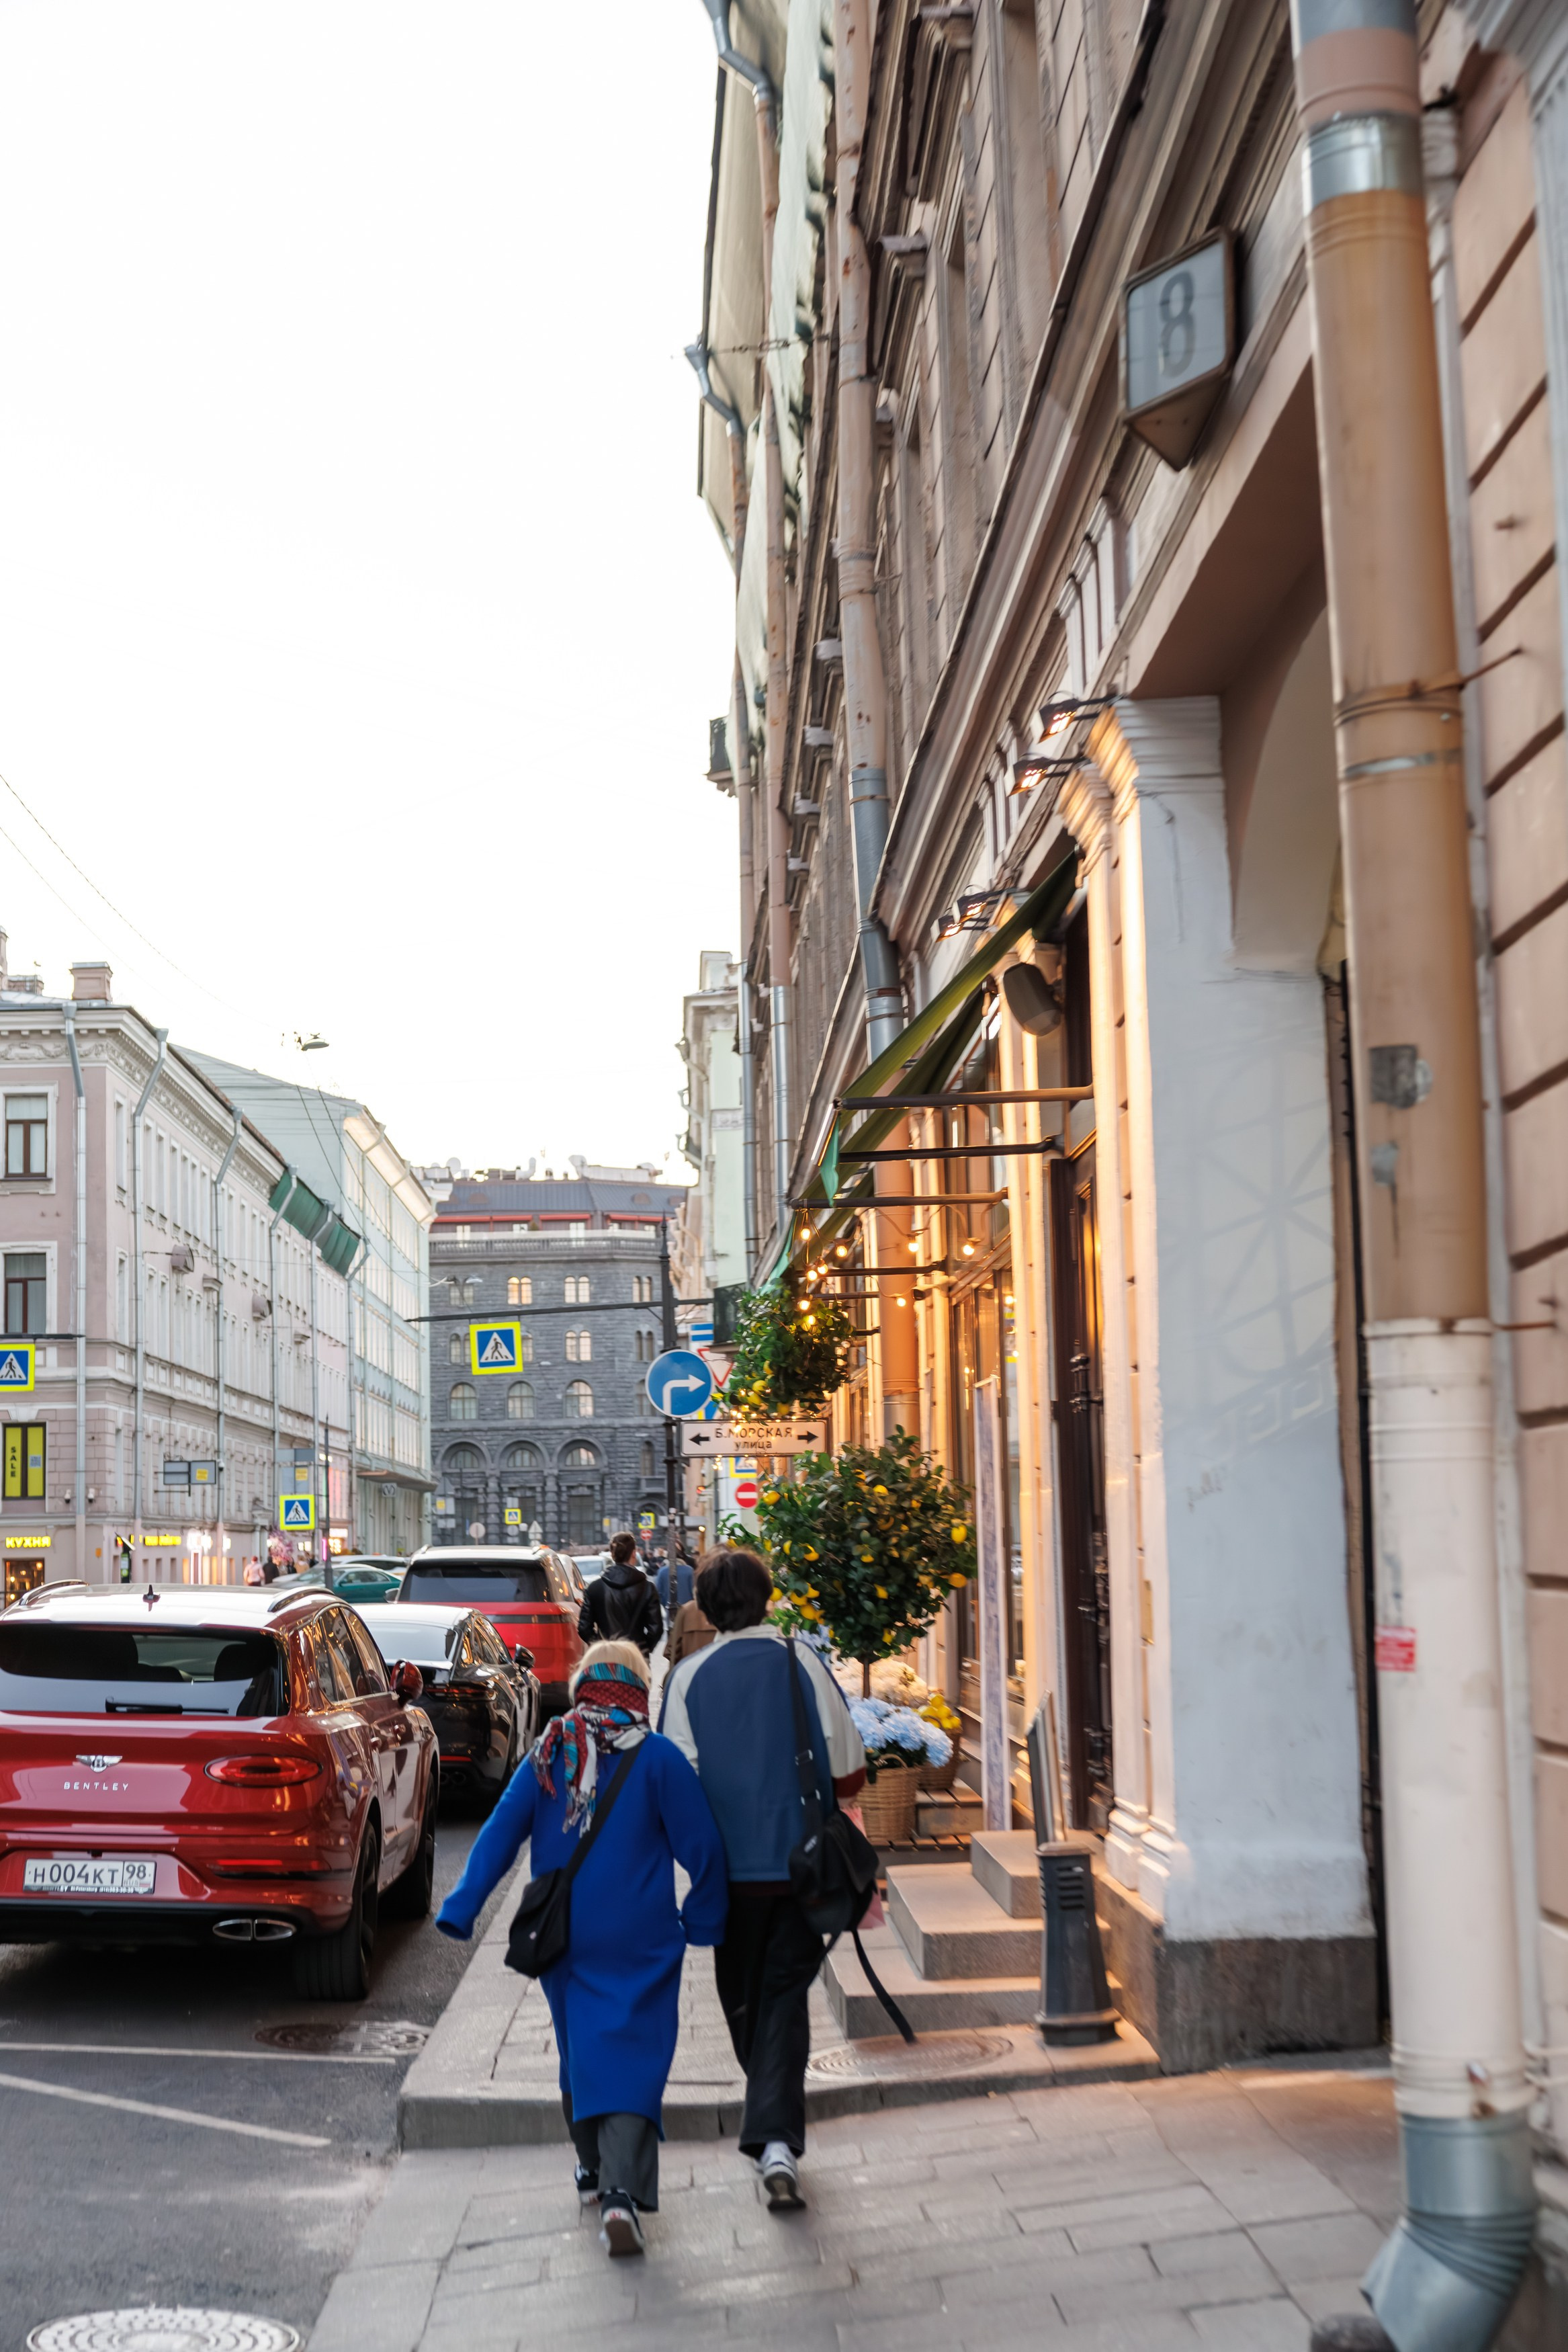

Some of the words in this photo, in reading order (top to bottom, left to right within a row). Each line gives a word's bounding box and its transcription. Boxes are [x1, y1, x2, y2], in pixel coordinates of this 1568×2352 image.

[1159, 270, 1195, 379] 8
[734, 1441, 773, 1452] улица
[5, 1536, 51, 1548] КУХНЯ
[63, 1781, 129, 1791] BENTLEY
[126, 1863, 146, 1880] 98
